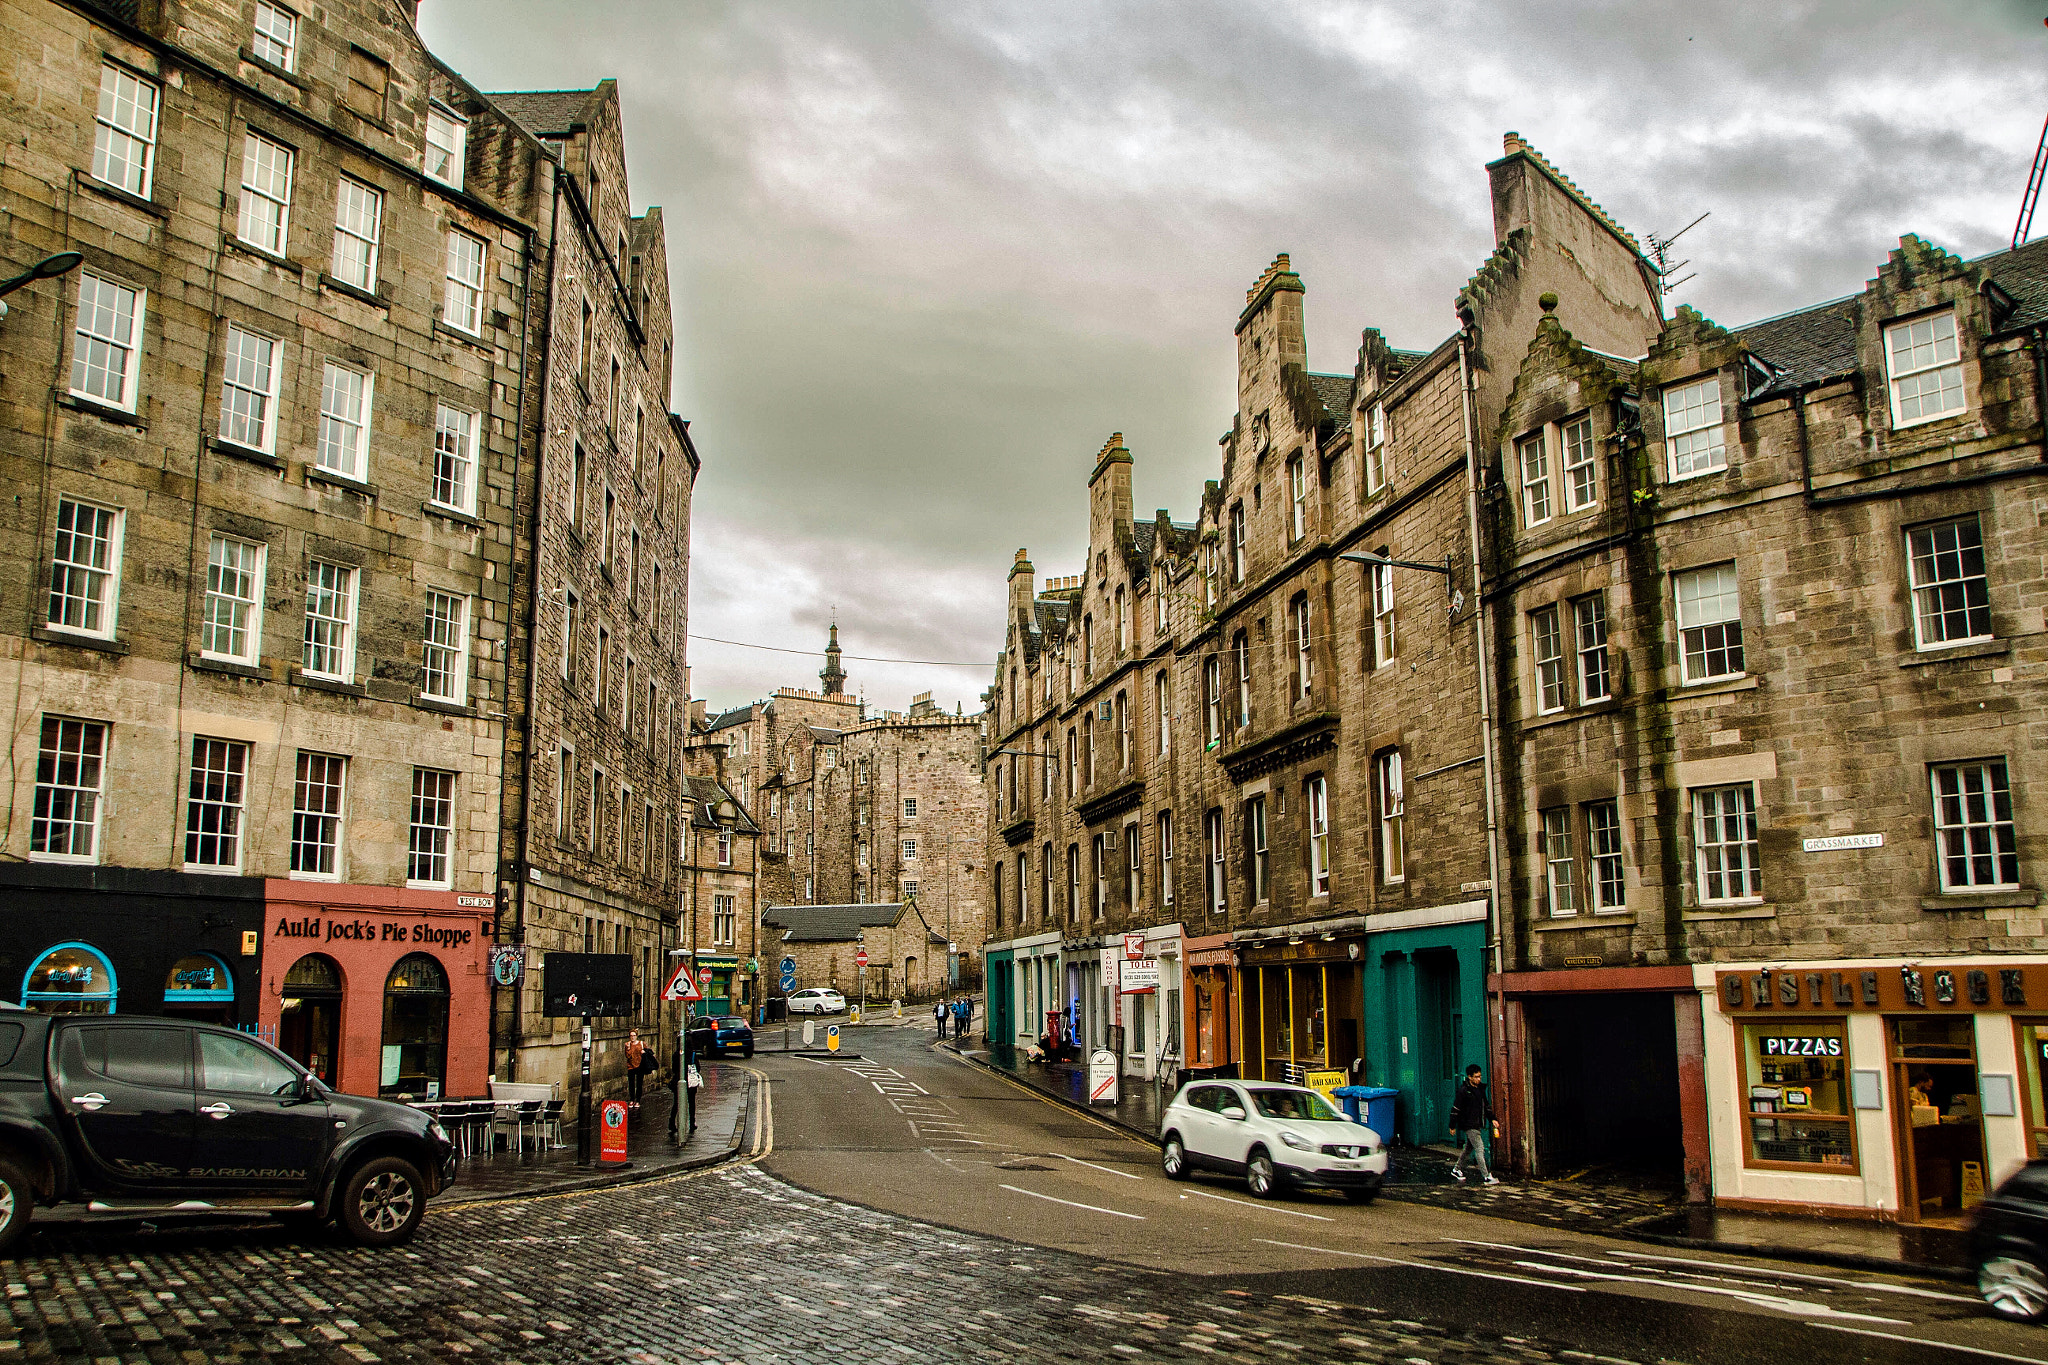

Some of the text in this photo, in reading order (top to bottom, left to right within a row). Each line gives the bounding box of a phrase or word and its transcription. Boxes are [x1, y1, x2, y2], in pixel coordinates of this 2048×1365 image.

[1805, 836, 1880, 849] GRASSMARKET
[459, 897, 493, 907] WEST BOW
[275, 917, 472, 948] Auld Jock's Pie Shoppe
[1212, 949, 1230, 961] FOSSILS
[1105, 951, 1113, 985] LAUNDRY
[1141, 960, 1155, 968] LET
[1723, 968, 2026, 1007] CASTLE ROCK
[1767, 1038, 1841, 1056] PIZZAS
[1311, 1077, 1342, 1086] BAR SALSA
[188, 1167, 306, 1179] BARBARIAN
